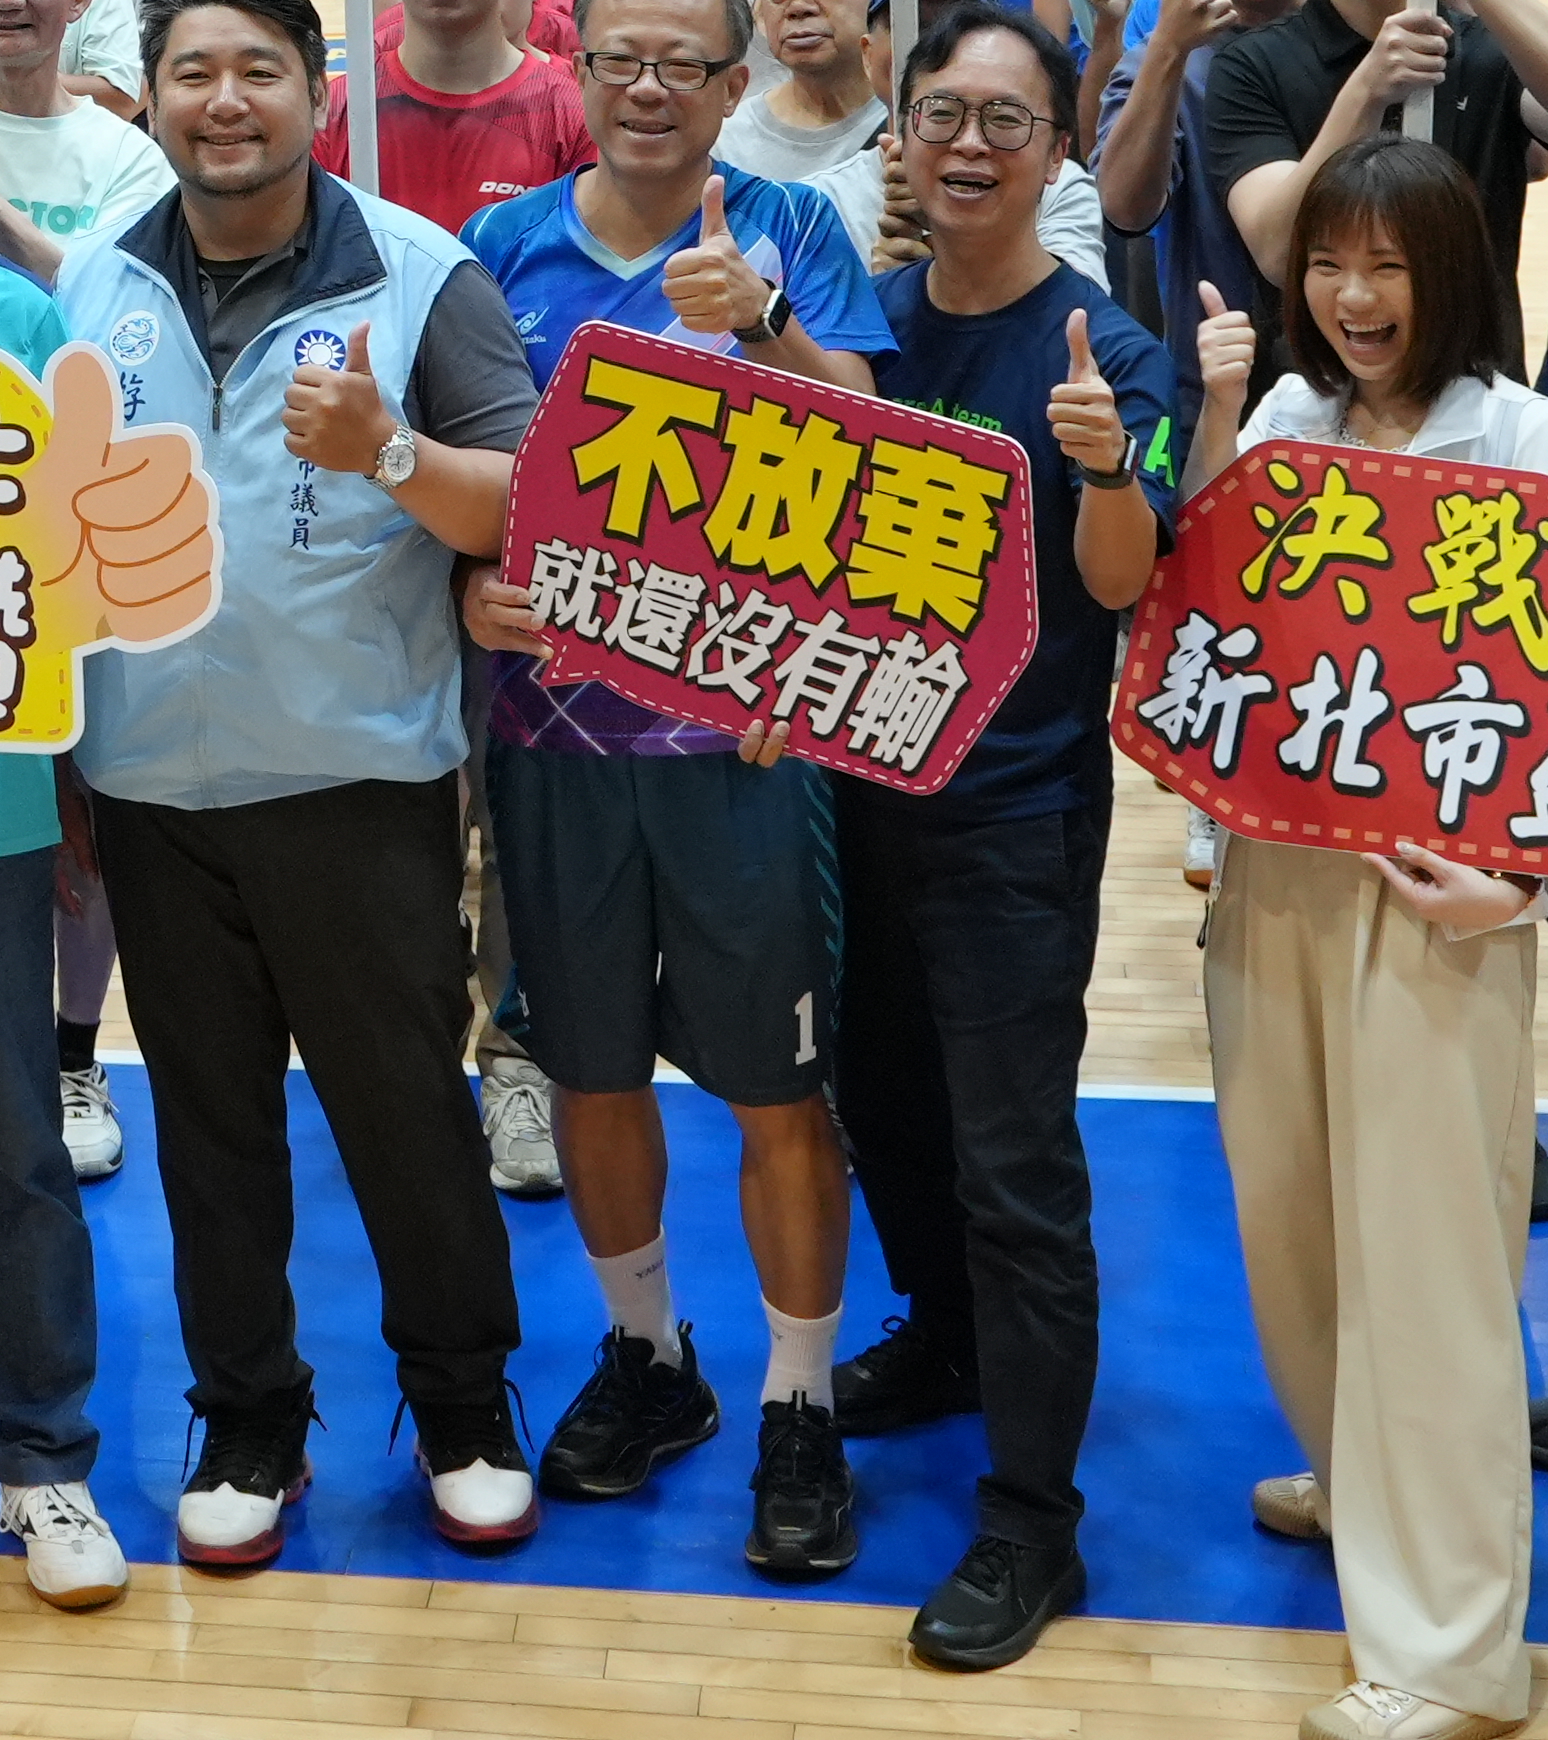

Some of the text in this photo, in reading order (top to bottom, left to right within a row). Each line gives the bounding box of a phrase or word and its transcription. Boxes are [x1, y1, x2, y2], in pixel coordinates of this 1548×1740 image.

[569, 356, 1011, 634] 不放棄
[528, 538, 970, 777] 就還沒有輸
[794, 991, 817, 1066] 1
